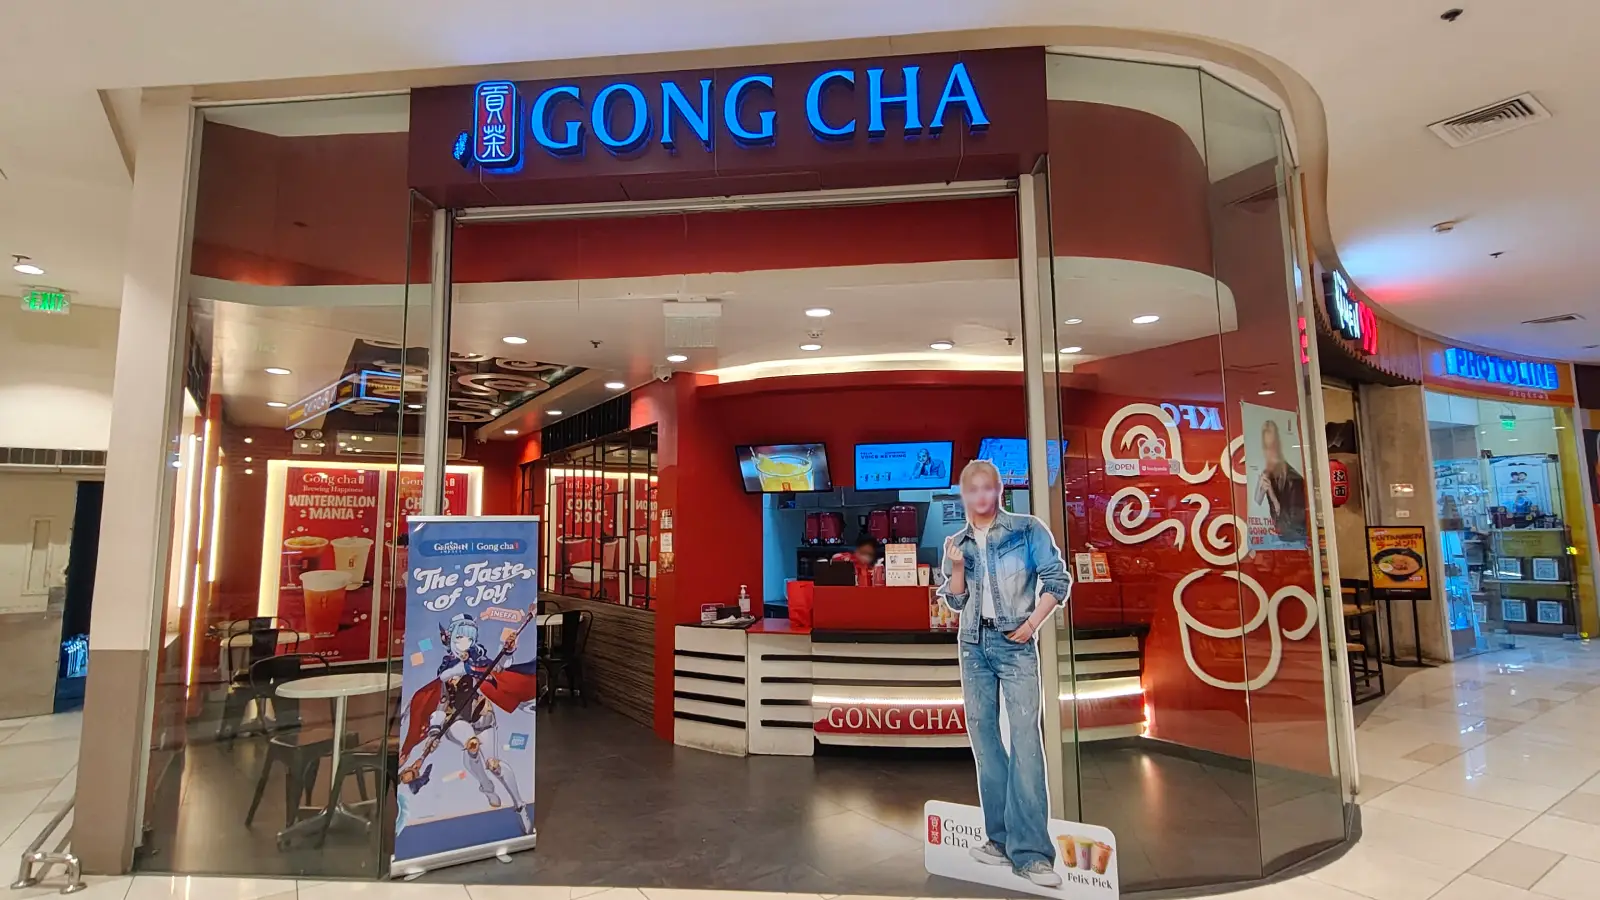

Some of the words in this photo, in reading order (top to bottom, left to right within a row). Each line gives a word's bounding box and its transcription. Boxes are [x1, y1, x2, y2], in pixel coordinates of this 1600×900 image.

[530, 75, 777, 151] GONG
[805, 61, 991, 137] CHA
[480, 85, 509, 158] 貢茶
[29, 291, 65, 312] EXIT
[1450, 348, 1559, 390] PHOTOLINE
[1114, 463, 1135, 471] OPEN
[302, 473, 335, 485] Gong
[337, 473, 357, 484] cha
[303, 485, 330, 494] Brewing
[288, 494, 376, 508] WINTERMELON
[309, 507, 354, 520] MANIA
[476, 543, 499, 552] Gong
[499, 542, 514, 550] cha
[413, 567, 459, 594] The
[464, 560, 535, 587] Taste
[423, 587, 463, 611] of
[490, 610, 517, 620] INEFFA
[828, 707, 901, 730] GONG
[909, 708, 963, 730] CHA
[943, 818, 982, 841] Gong
[944, 832, 969, 849] cha
[1067, 872, 1090, 885] Felix
[1092, 878, 1113, 890] Pick
